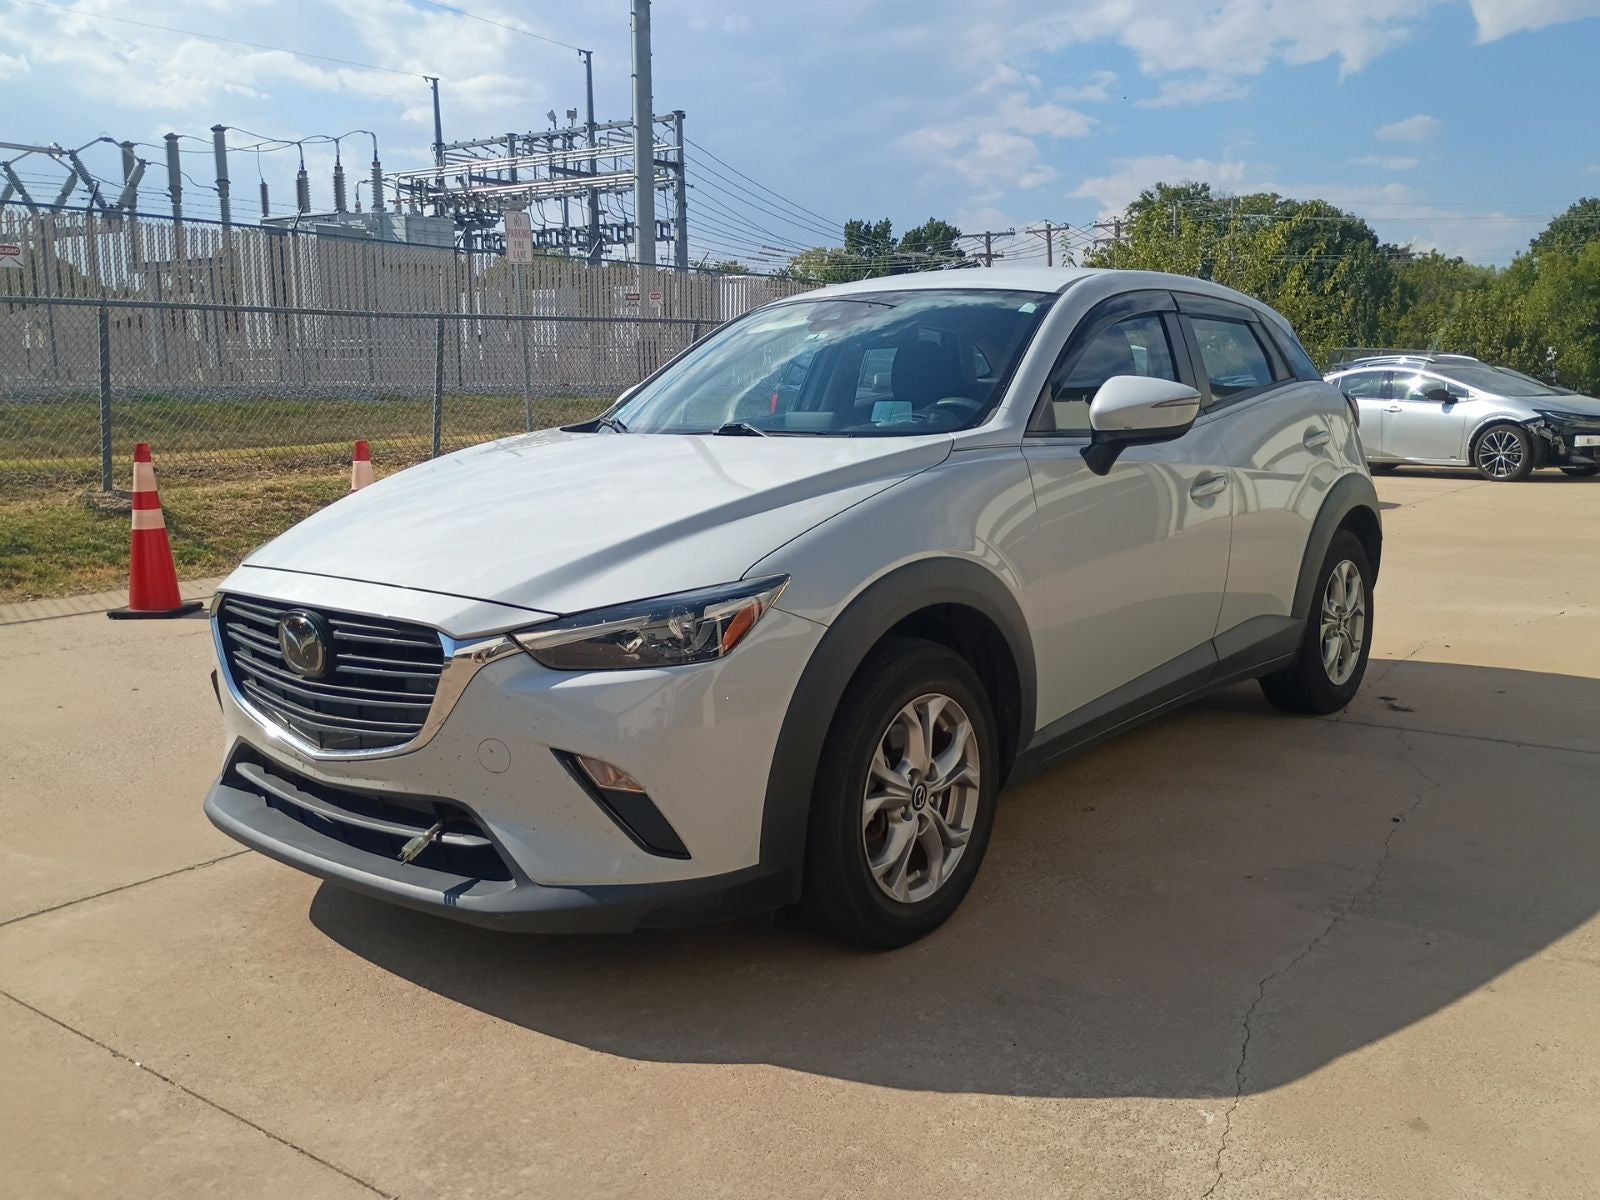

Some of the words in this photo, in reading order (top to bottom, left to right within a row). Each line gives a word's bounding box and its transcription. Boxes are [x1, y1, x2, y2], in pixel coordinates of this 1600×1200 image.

[513, 217, 522, 227] NO
[507, 228, 530, 239] PARKING
[514, 240, 525, 249] FIRE
[513, 250, 526, 259] LANE
